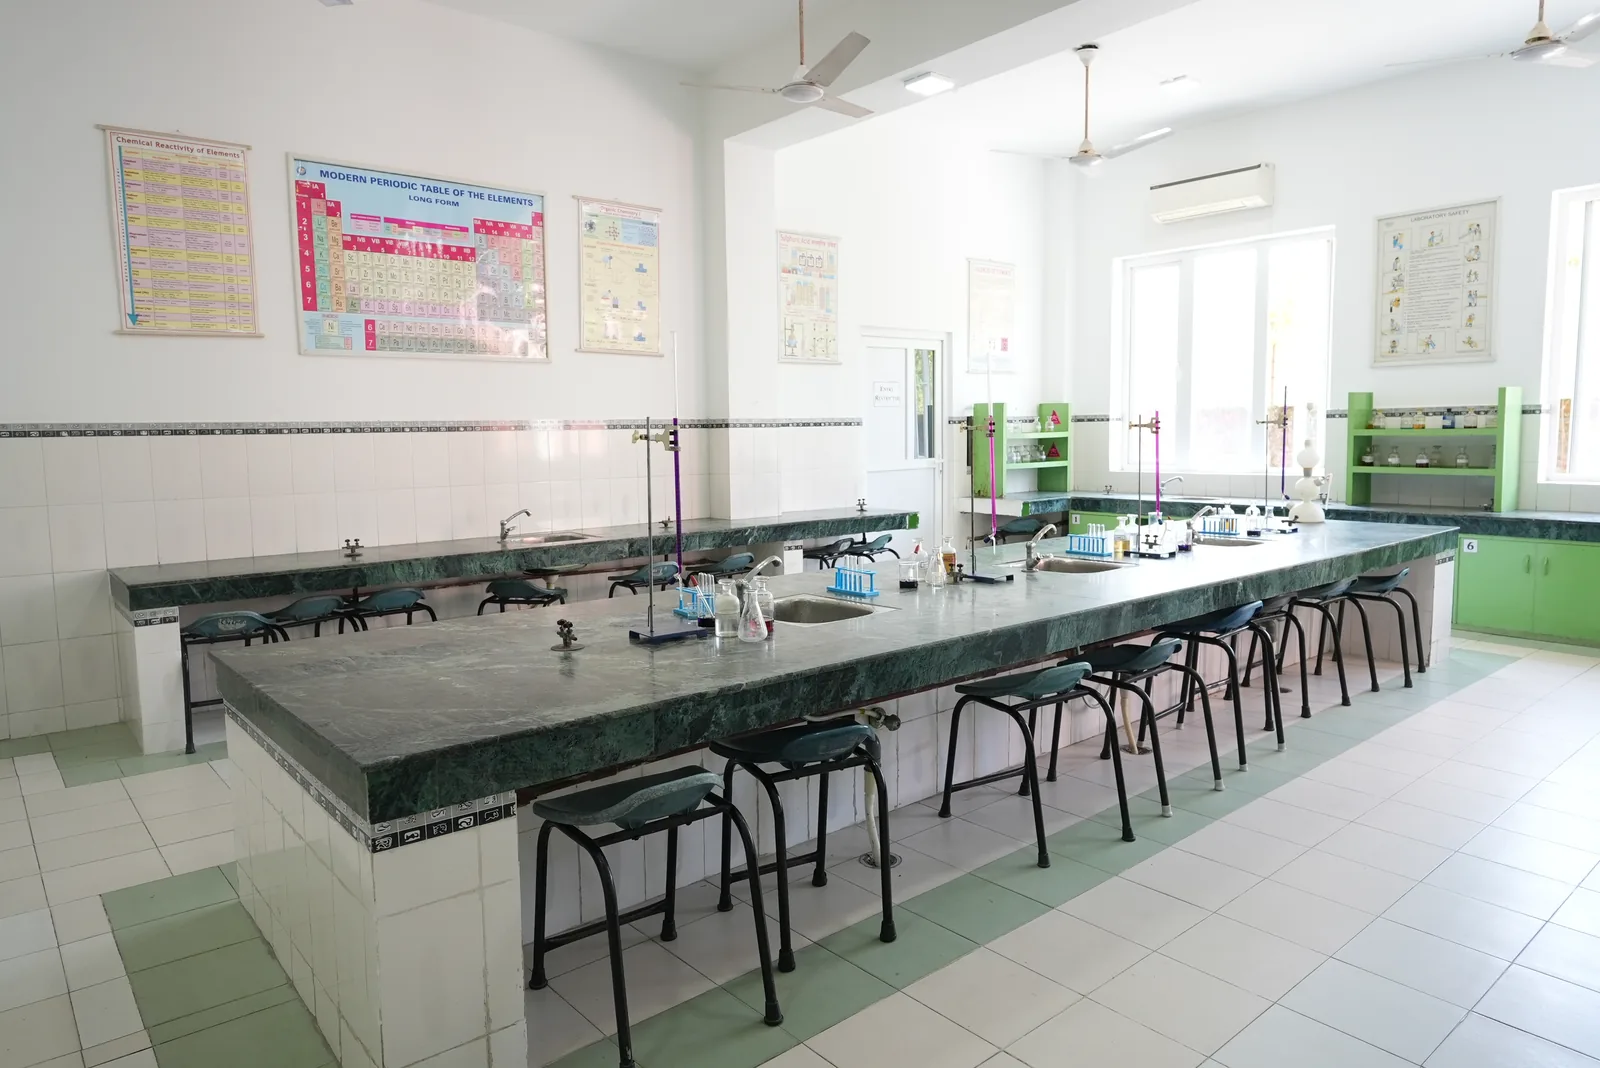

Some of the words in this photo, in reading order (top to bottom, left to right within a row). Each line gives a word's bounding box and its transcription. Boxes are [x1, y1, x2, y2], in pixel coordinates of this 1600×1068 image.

[116, 136, 152, 147] Chemical
[155, 141, 194, 154] Reactivity
[206, 148, 240, 159] Elements
[320, 169, 367, 184] MODERN
[370, 177, 418, 190] PERIODIC
[420, 184, 450, 195] TABLE
[453, 188, 465, 197] OF
[467, 190, 485, 200] THE
[488, 194, 534, 207] ELEMENTS
[409, 195, 433, 204] LONG
[435, 198, 460, 207] FORM
[1410, 212, 1446, 222] LABORATORY
[1448, 209, 1470, 217] SAFETY
[1466, 541, 1475, 551] 6
